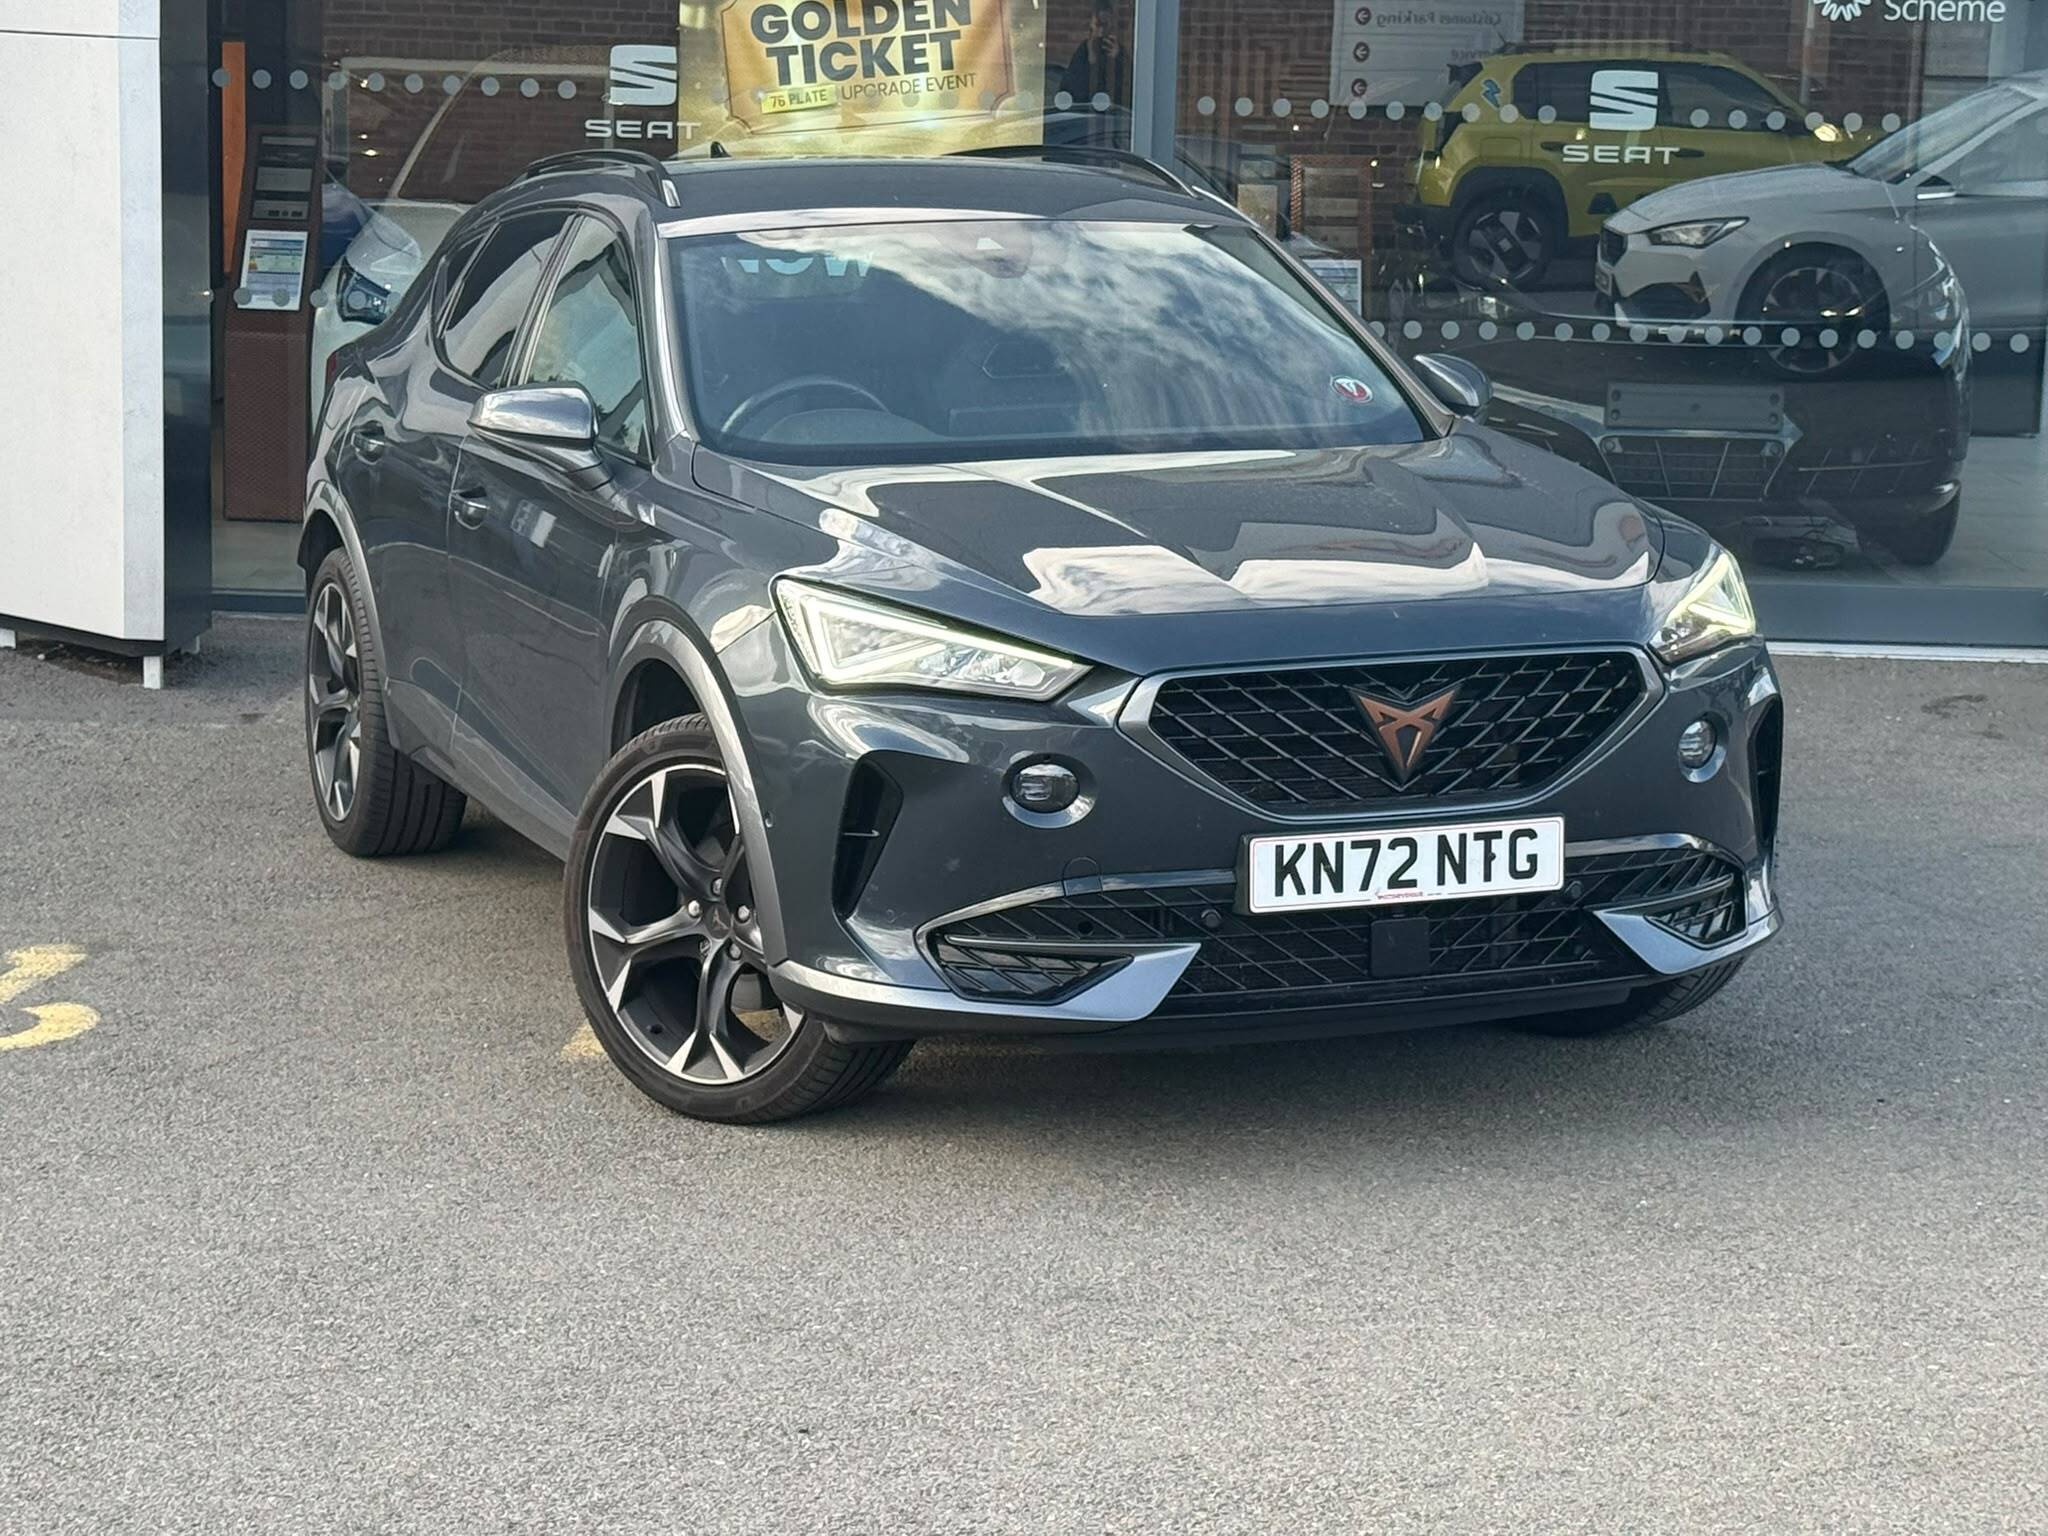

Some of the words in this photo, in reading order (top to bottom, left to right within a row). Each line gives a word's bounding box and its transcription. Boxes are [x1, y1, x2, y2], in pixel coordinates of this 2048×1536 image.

[750, 0, 972, 44] GOLDEN
[1883, 0, 2006, 22] Scheme
[765, 30, 961, 86] TICKET
[788, 89, 828, 105] PLATE
[841, 79, 921, 101] UPGRADE
[926, 73, 976, 92] EVENT
[584, 119, 701, 139] SEAT
[1562, 144, 1680, 164] SEAT
[1273, 836, 1418, 897] KN72
[1437, 828, 1538, 887] NTG
